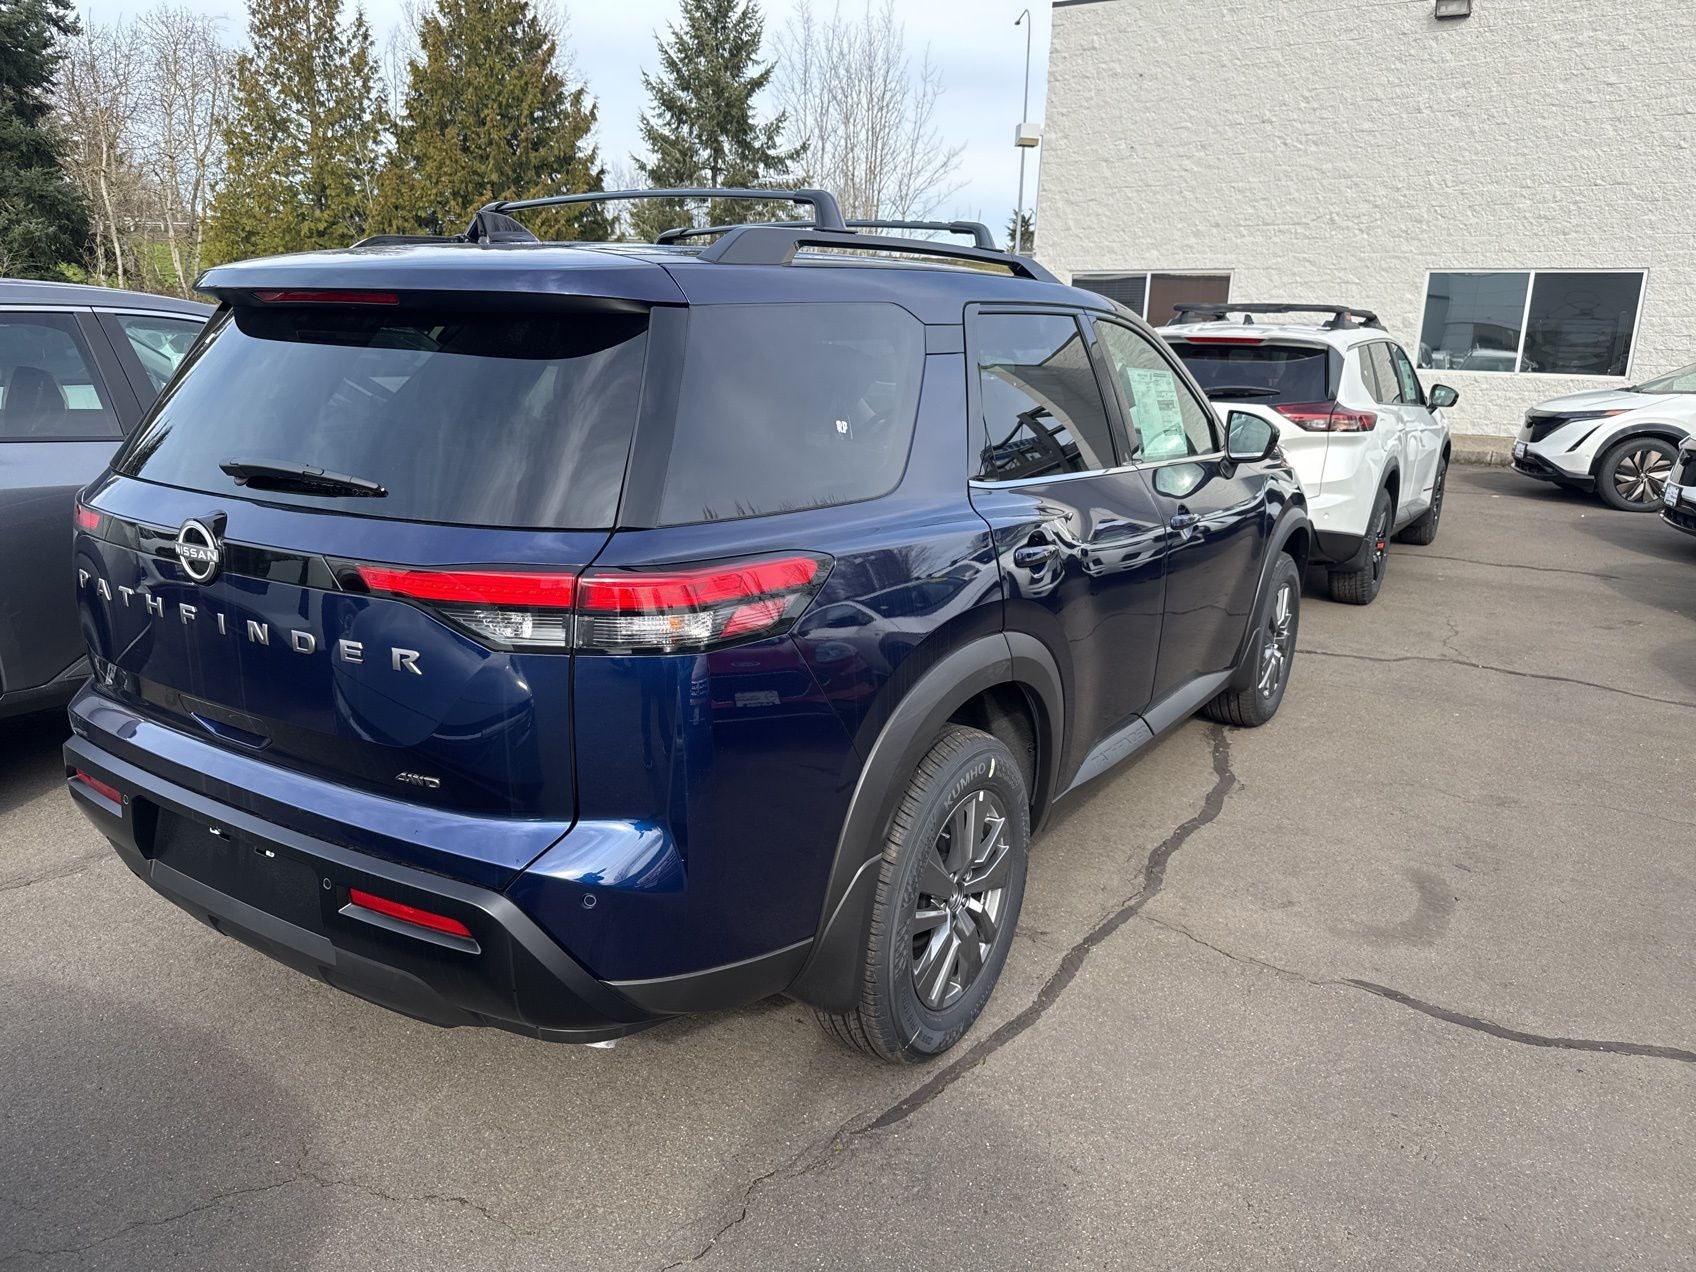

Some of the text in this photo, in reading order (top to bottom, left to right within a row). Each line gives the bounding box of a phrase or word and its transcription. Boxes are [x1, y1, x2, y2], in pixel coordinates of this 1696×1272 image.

[175, 543, 217, 561] NISSAN
[78, 567, 423, 676] PATHFINDER
[395, 771, 440, 789] 4WD
[944, 762, 986, 809] KUMHO
